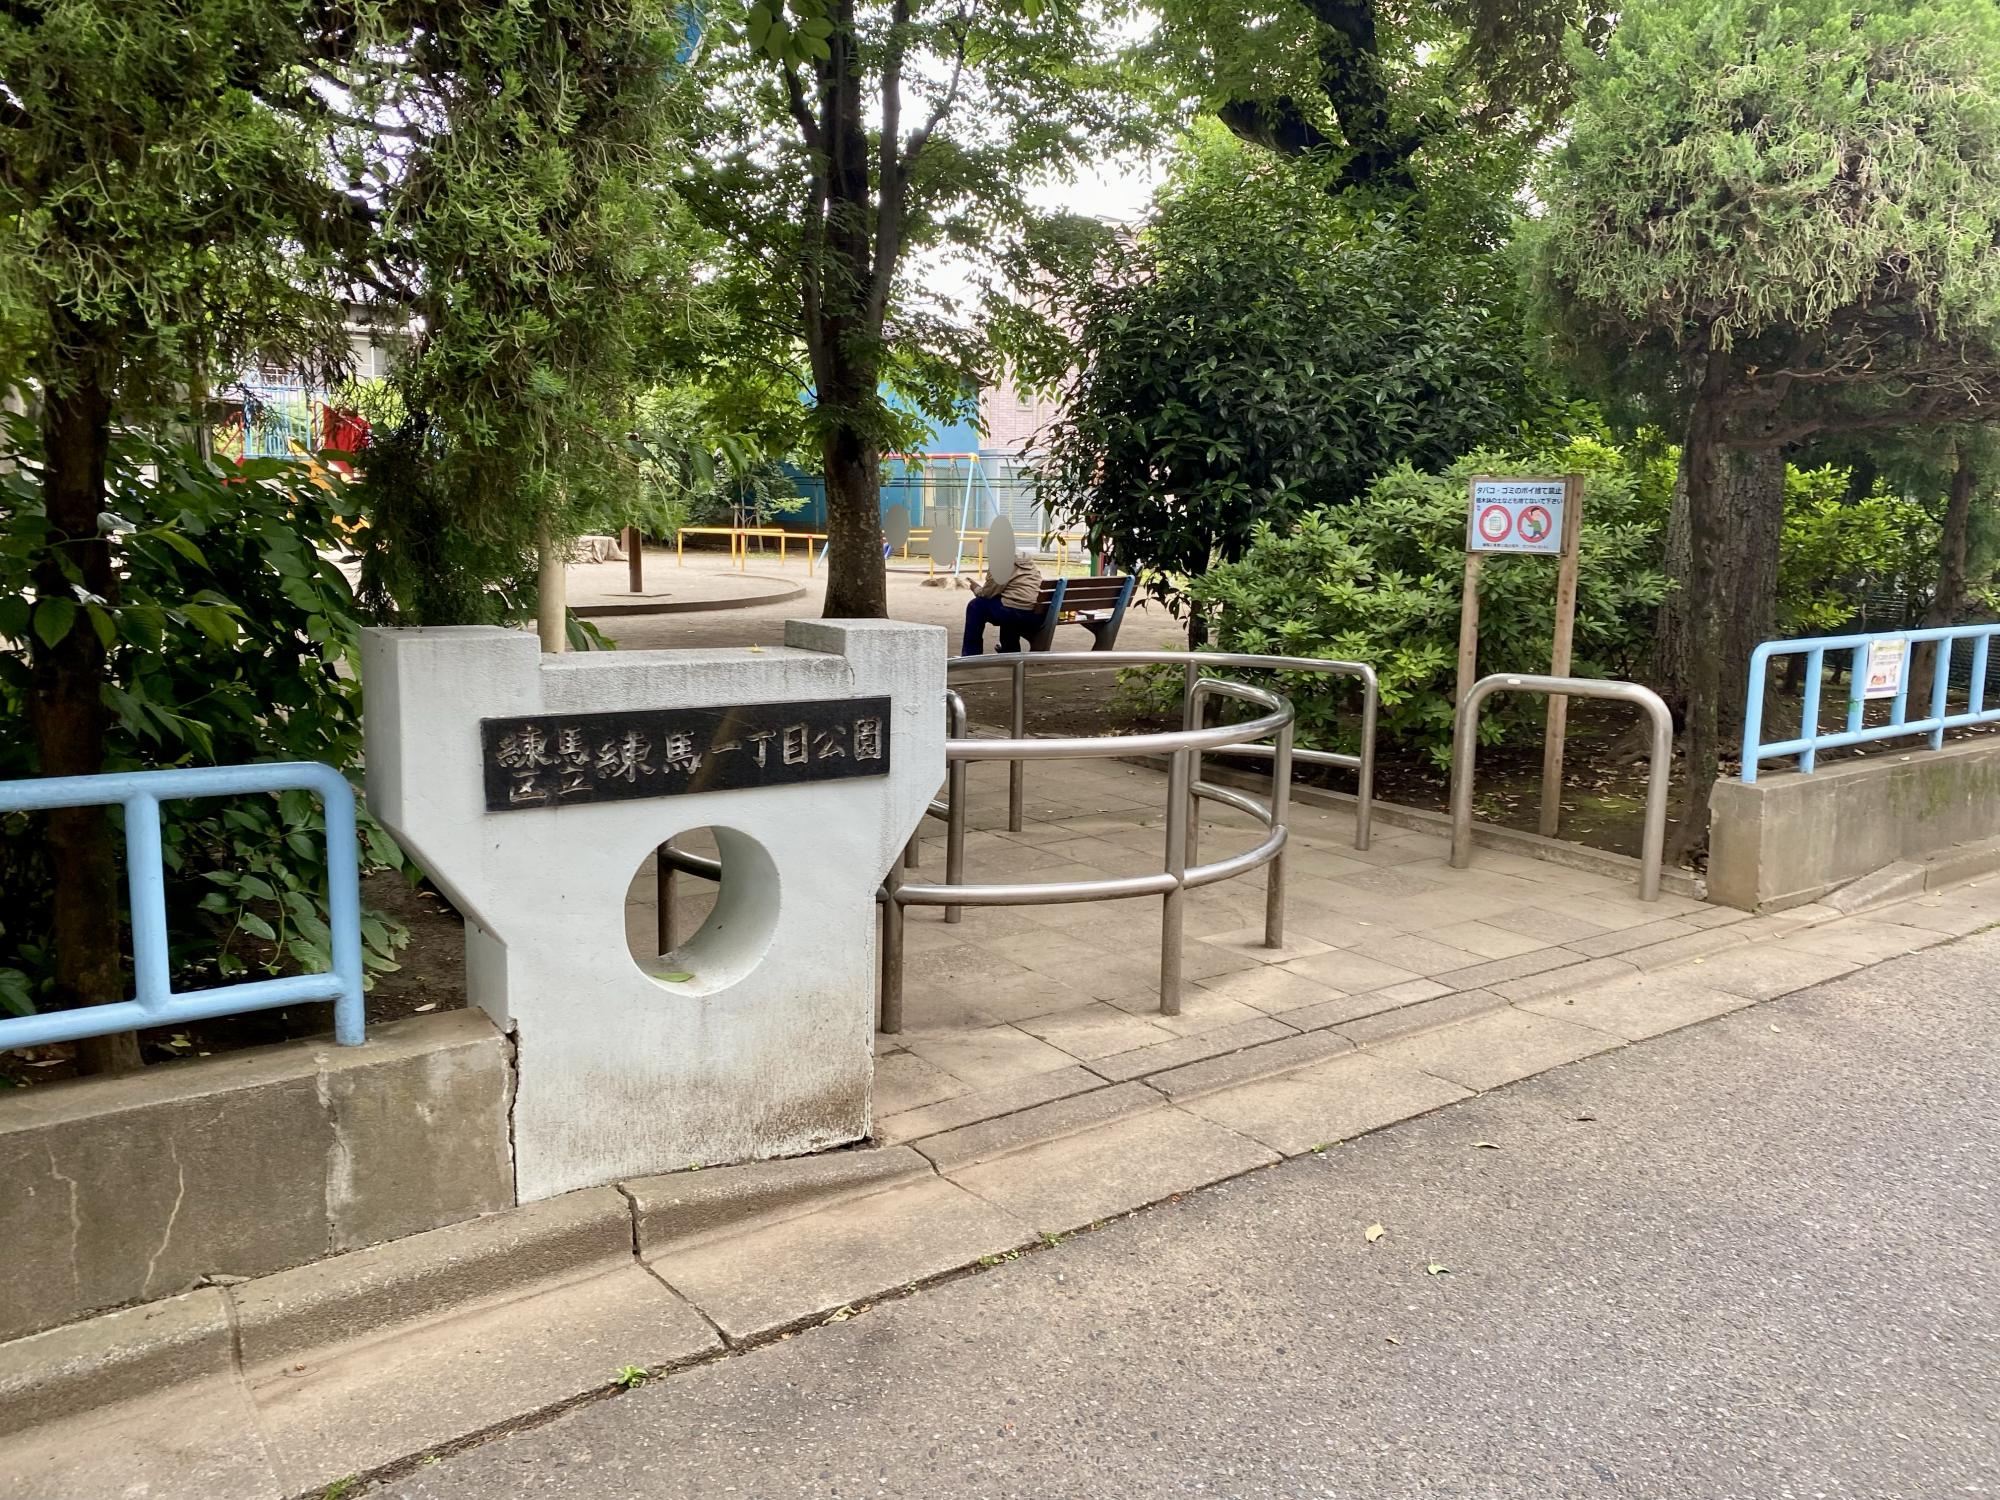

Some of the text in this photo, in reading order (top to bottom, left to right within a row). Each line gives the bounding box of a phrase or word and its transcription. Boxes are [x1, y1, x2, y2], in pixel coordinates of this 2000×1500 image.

[495, 725, 590, 769] 練馬
[594, 717, 883, 784] 練馬一丁目公園
[508, 765, 594, 803] 区立
